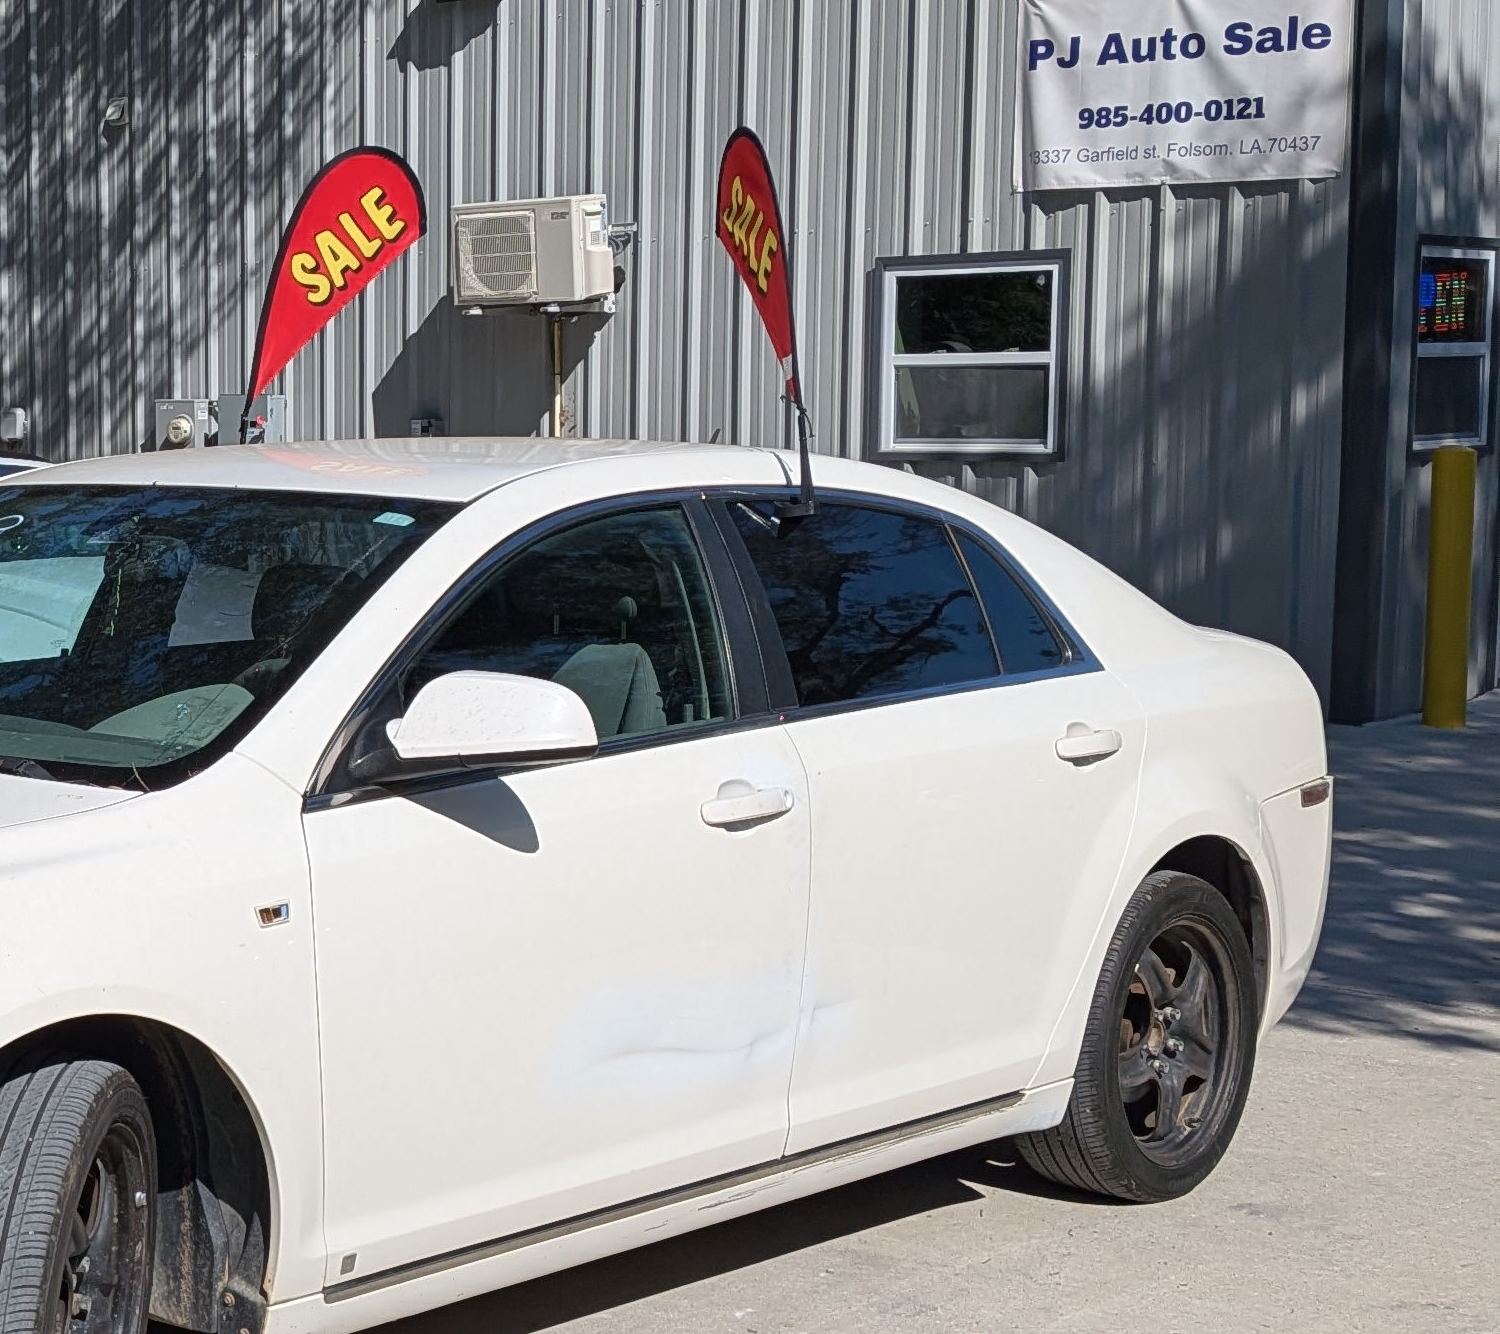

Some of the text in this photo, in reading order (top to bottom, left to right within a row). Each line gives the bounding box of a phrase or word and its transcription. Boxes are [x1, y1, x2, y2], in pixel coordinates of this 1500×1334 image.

[1028, 16, 1332, 71] PJ Auto Sale
[1078, 97, 1265, 129] 985-400-0121
[1076, 145, 1139, 163] Garfield
[1143, 144, 1161, 159] st.
[1167, 142, 1233, 158] Folsom.
[1239, 135, 1321, 155] LA.70437
[291, 186, 406, 304] SALE
[723, 175, 778, 294] SALE
